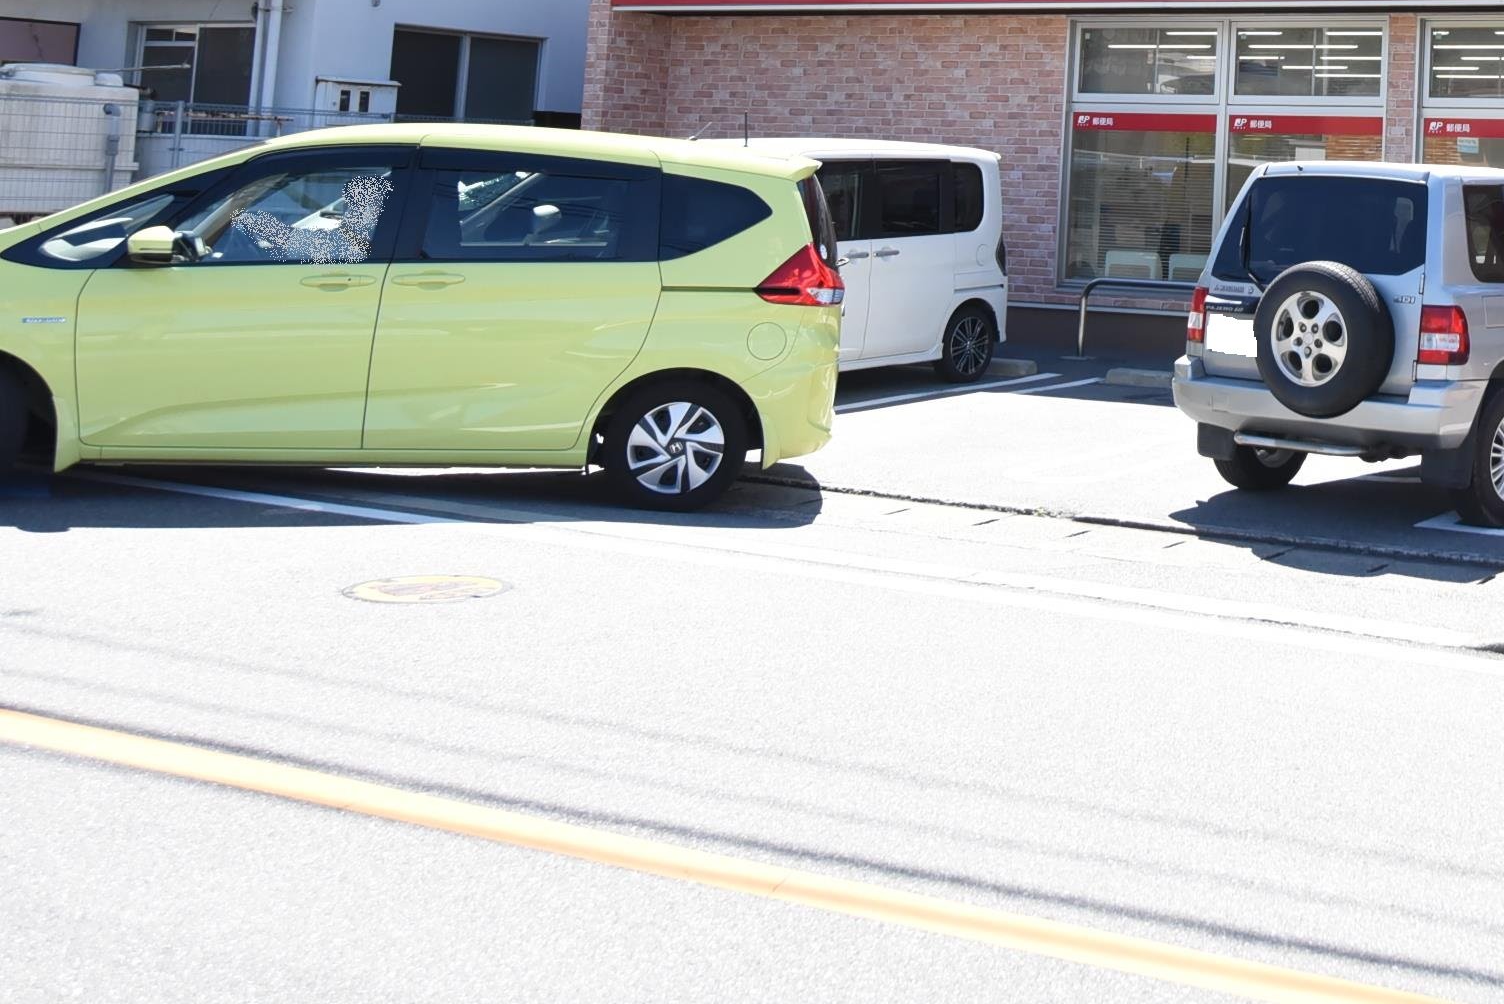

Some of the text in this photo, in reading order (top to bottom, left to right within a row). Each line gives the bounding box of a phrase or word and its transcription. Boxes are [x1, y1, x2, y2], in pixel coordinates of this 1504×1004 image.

[1092, 117, 1114, 126] 郵便局
[1250, 119, 1272, 129] 郵便局
[1446, 123, 1470, 133] 郵便局
